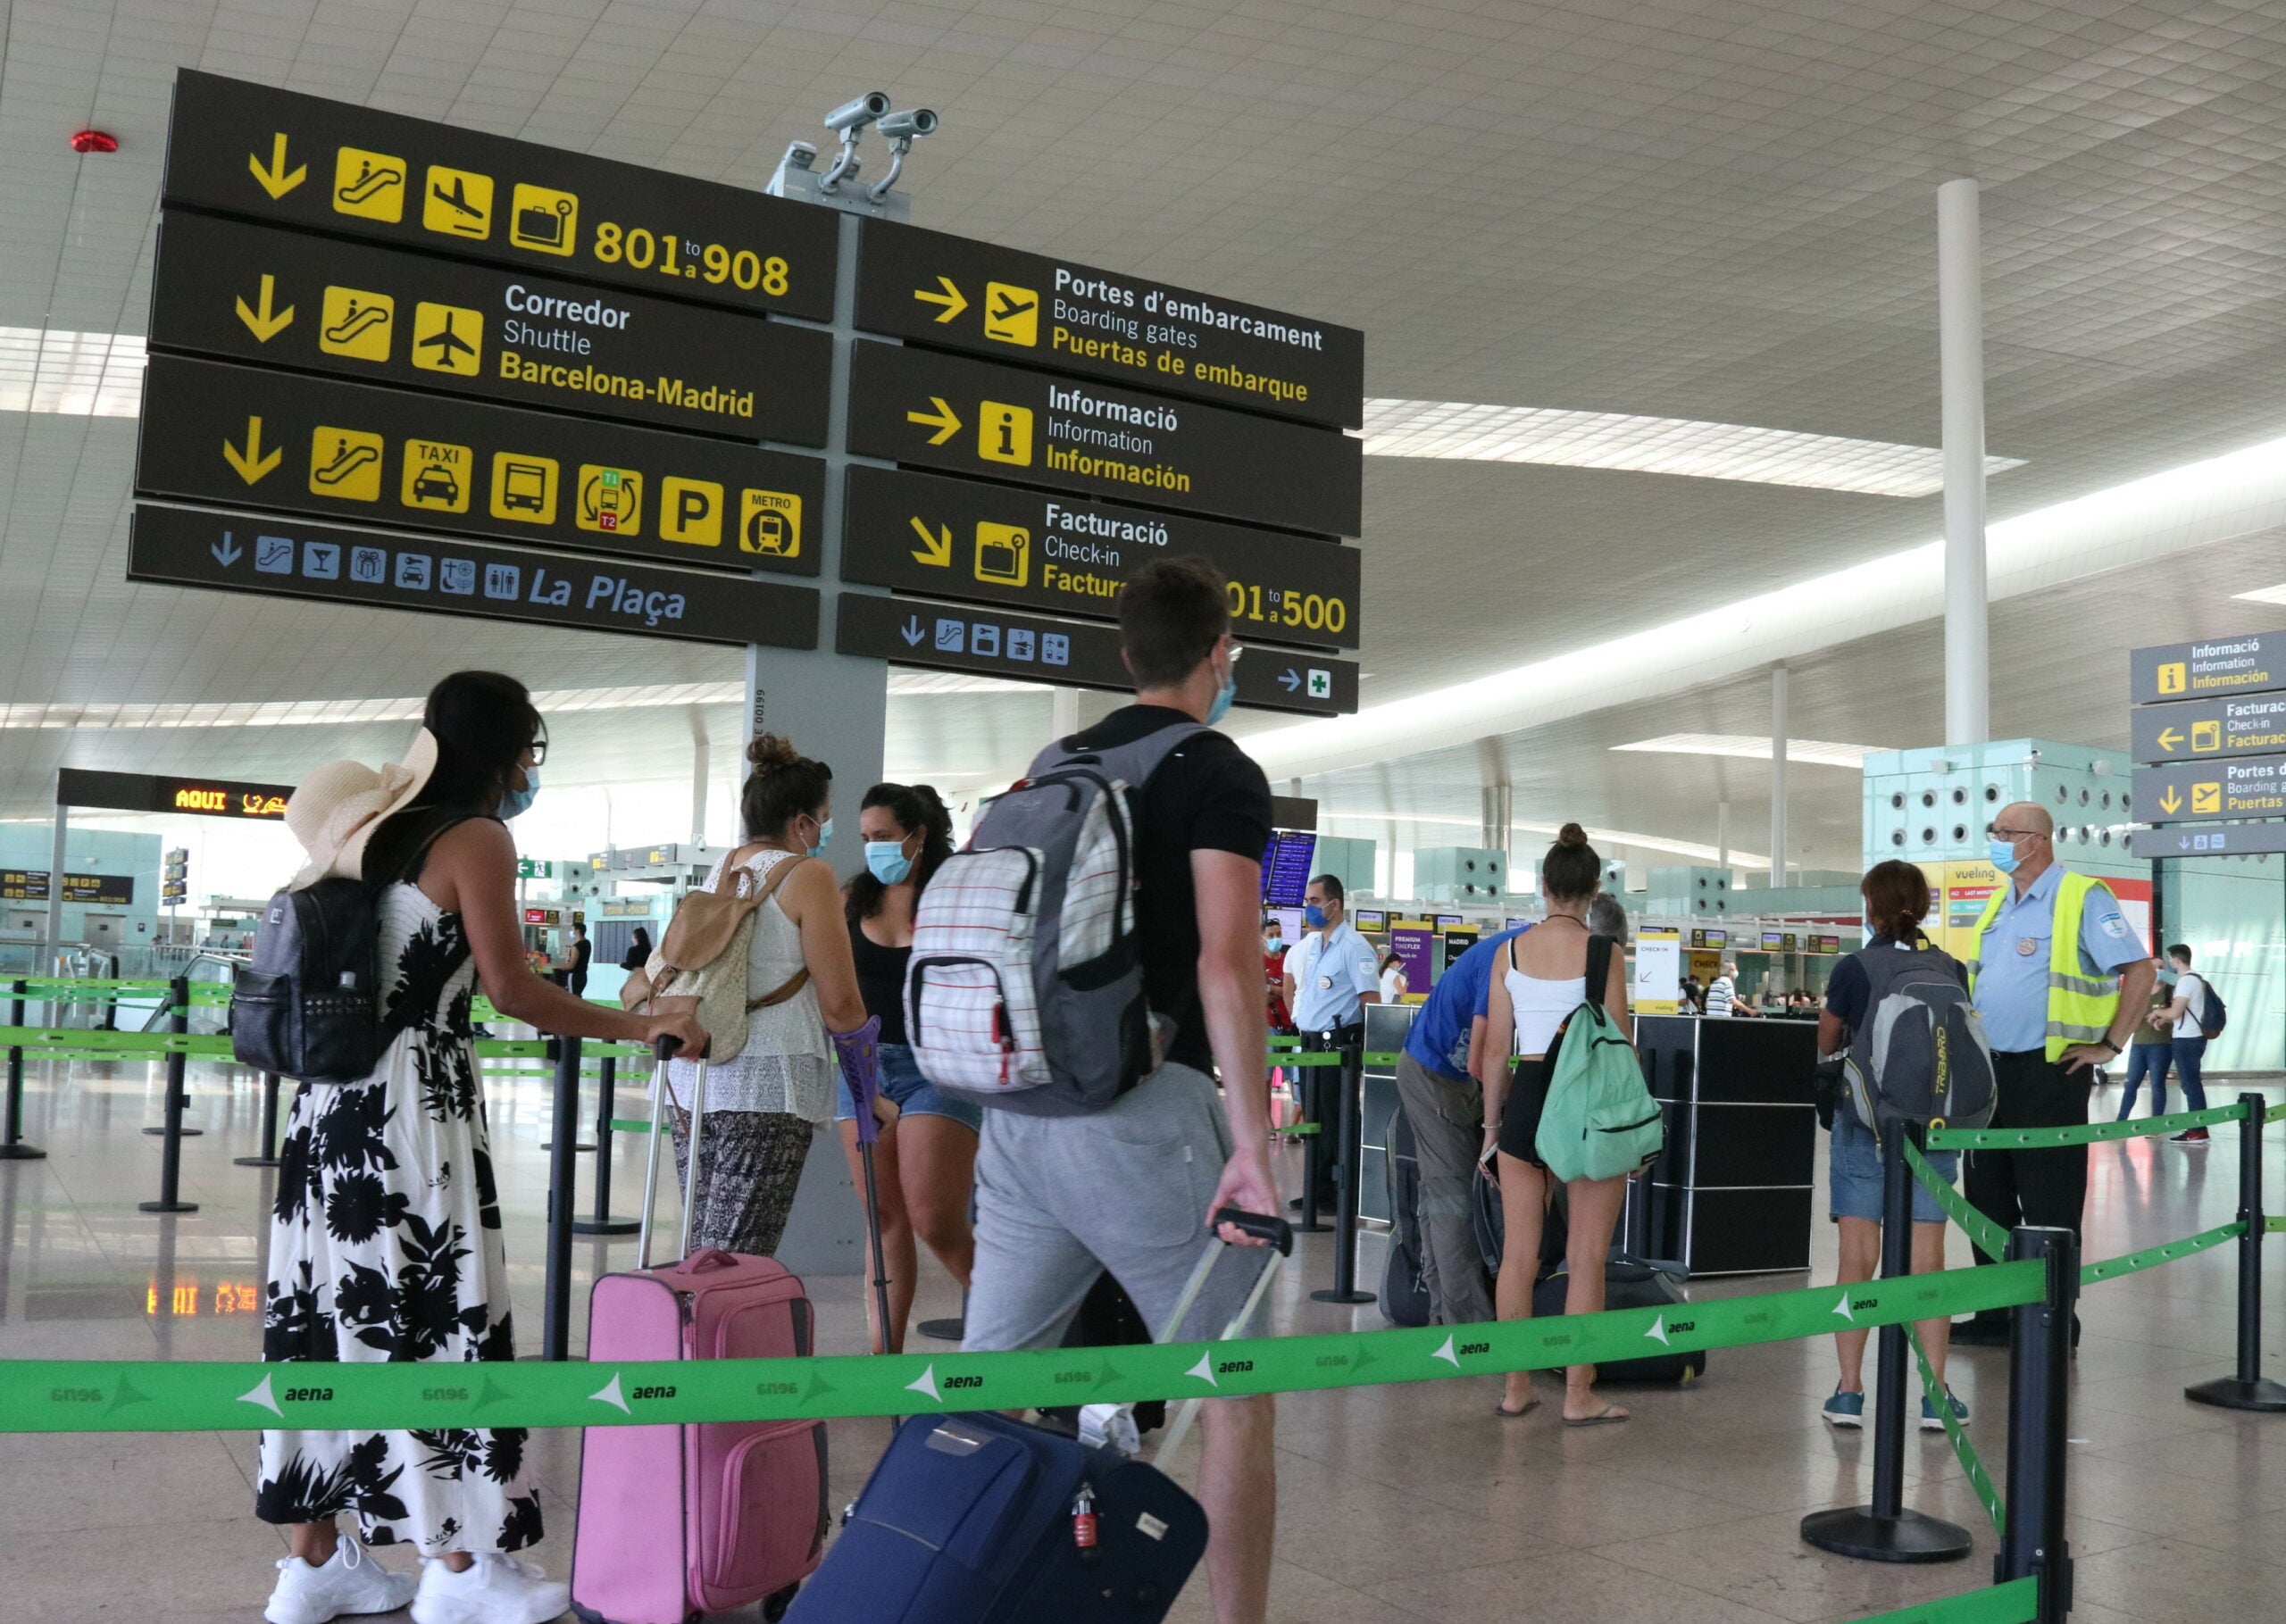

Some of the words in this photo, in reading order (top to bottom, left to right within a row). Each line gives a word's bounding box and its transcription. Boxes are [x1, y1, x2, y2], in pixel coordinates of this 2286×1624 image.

[595, 222, 680, 275] 801
[686, 240, 700, 256] to
[686, 265, 696, 278] a
[704, 245, 788, 296] 908
[505, 285, 630, 330] Corredor
[1055, 269, 1134, 308] Portes
[1145, 291, 1322, 351] d'embarcament
[1055, 299, 1139, 340] Boarding
[1147, 325, 1197, 349] gates
[505, 319, 590, 355] Shuttle
[1054, 327, 1147, 368] Puertas
[1157, 351, 1185, 375] de
[1195, 363, 1308, 402] embarque
[501, 351, 753, 417] Barcelona-Madrid
[1049, 385, 1178, 432] Informació
[1048, 416, 1152, 454] Information
[419, 444, 460, 464] TAXI
[605, 472, 617, 485] T1
[1047, 445, 1190, 493] Información
[677, 489, 710, 533] P
[752, 494, 791, 509] METRO
[601, 515, 616, 527] T2
[1046, 504, 1168, 546] Facturació
[1045, 535, 1120, 567] Check-in
[1043, 564, 1128, 598] Factur
[530, 569, 571, 606] La
[586, 574, 686, 627] Plaça
[1225, 581, 1264, 621] 01
[1269, 589, 1281, 603] to
[1269, 611, 1278, 623] a
[1282, 590, 1346, 633] 500
[2192, 638, 2260, 659] Informació
[2192, 657, 2256, 673] Information
[2193, 669, 2269, 689] Información
[755, 689, 765, 724] 00199
[2227, 718, 2270, 731] Check-in
[2228, 766, 2274, 779] Portes
[2228, 780, 2278, 794] Boarding
[176, 789, 226, 811] AQUI
[2228, 796, 2284, 811] Puertas
[1956, 866, 1996, 882] vueling
[1395, 936, 1421, 944] PREMIUM
[1448, 938, 1470, 946] MADRID
[1853, 1299, 1878, 1310] aena
[1669, 1322, 1695, 1333] aena
[1460, 1343, 1489, 1354] aena
[1219, 1361, 1253, 1373] aena
[944, 1377, 982, 1388] aena
[285, 1388, 333, 1401] aena
[633, 1387, 676, 1399] aena
